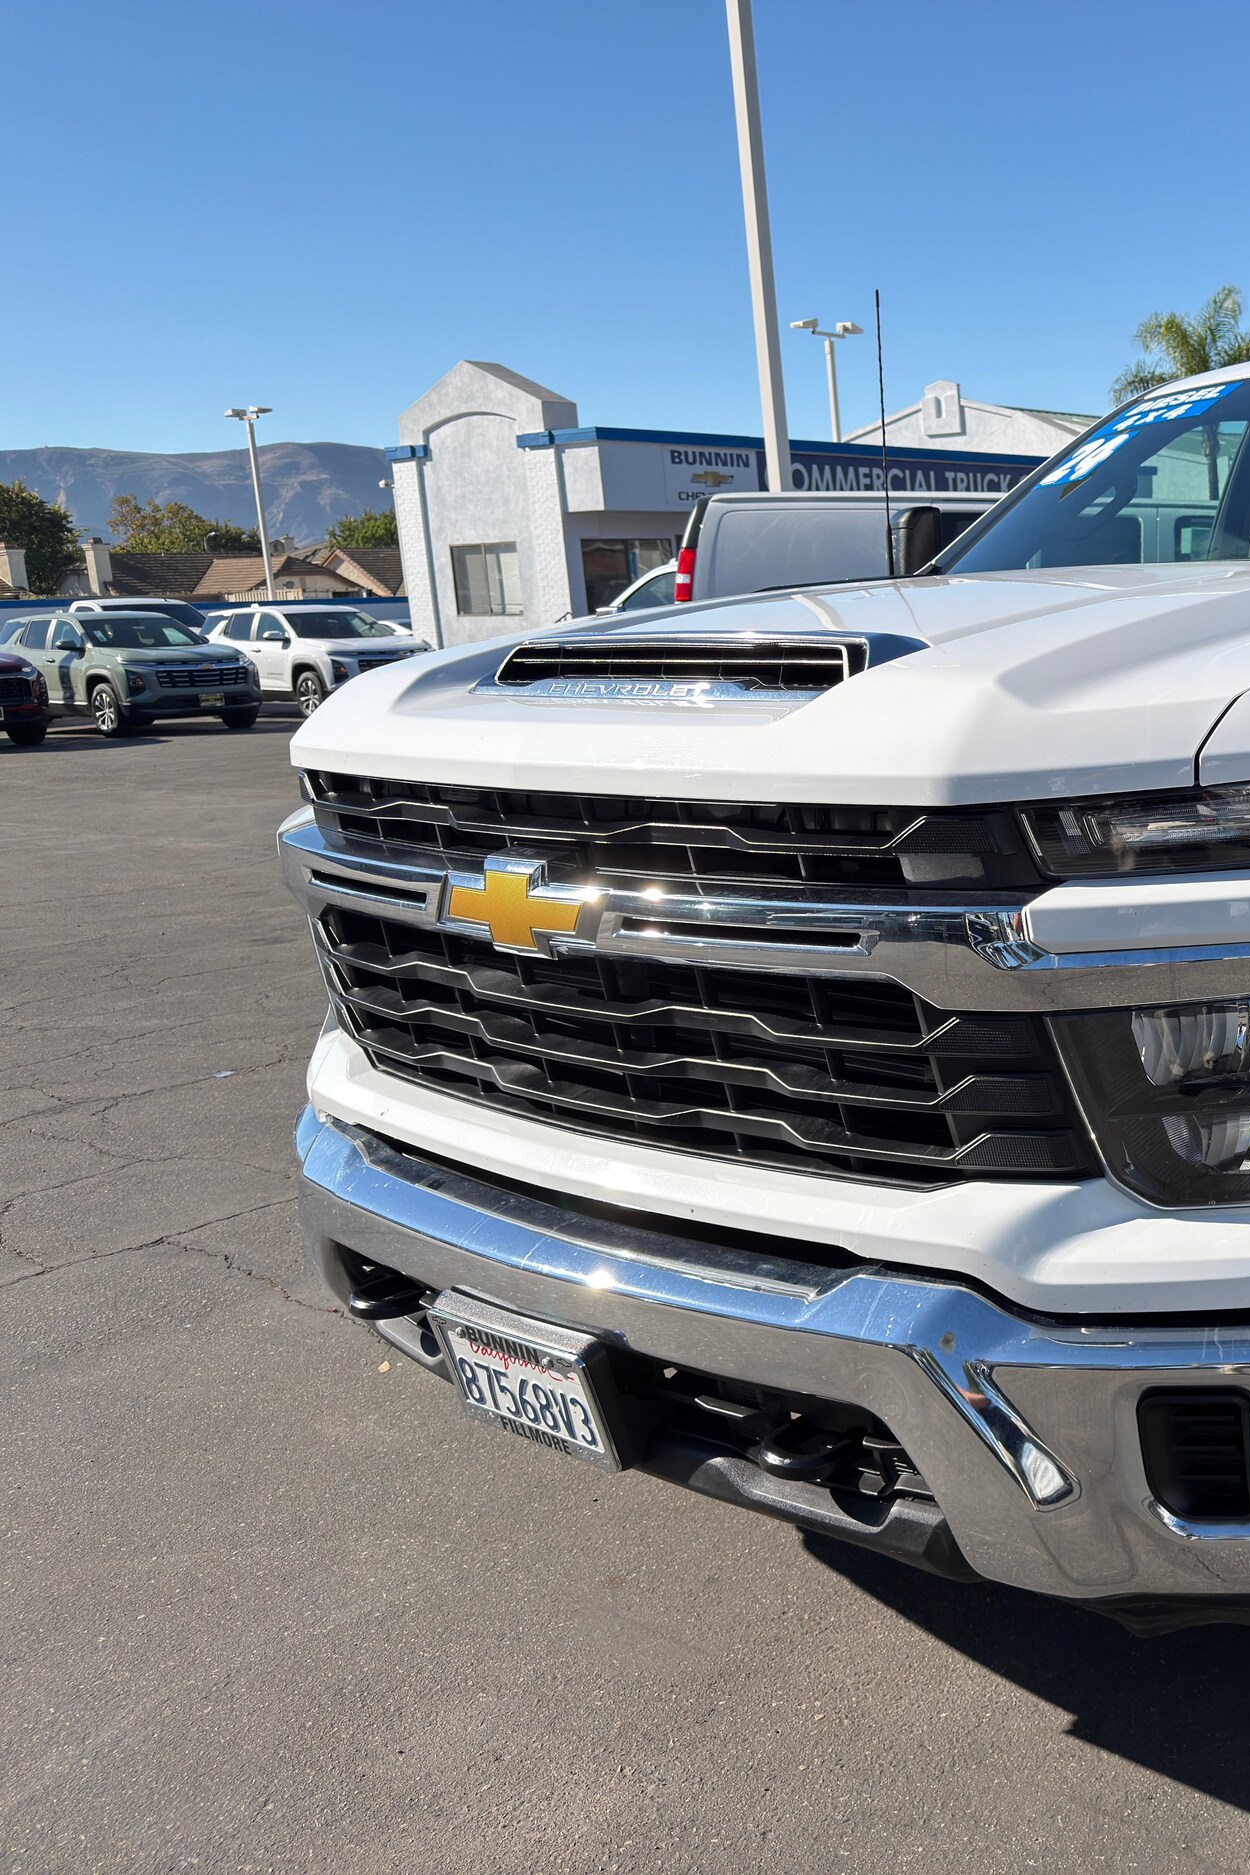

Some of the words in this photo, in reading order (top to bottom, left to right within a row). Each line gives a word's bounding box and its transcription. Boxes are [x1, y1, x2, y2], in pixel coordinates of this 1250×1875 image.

[1125, 384, 1227, 417] DIESEL
[670, 449, 751, 468] BUNNIN
[765, 461, 936, 492] OMMERCIAL
[1039, 432, 1131, 486] 24
[548, 682, 711, 699] CHEVROLET
[464, 1325, 541, 1365] BUNNIN
[458, 1356, 598, 1448] 87568V3
[500, 1415, 573, 1456] FILLMORE
